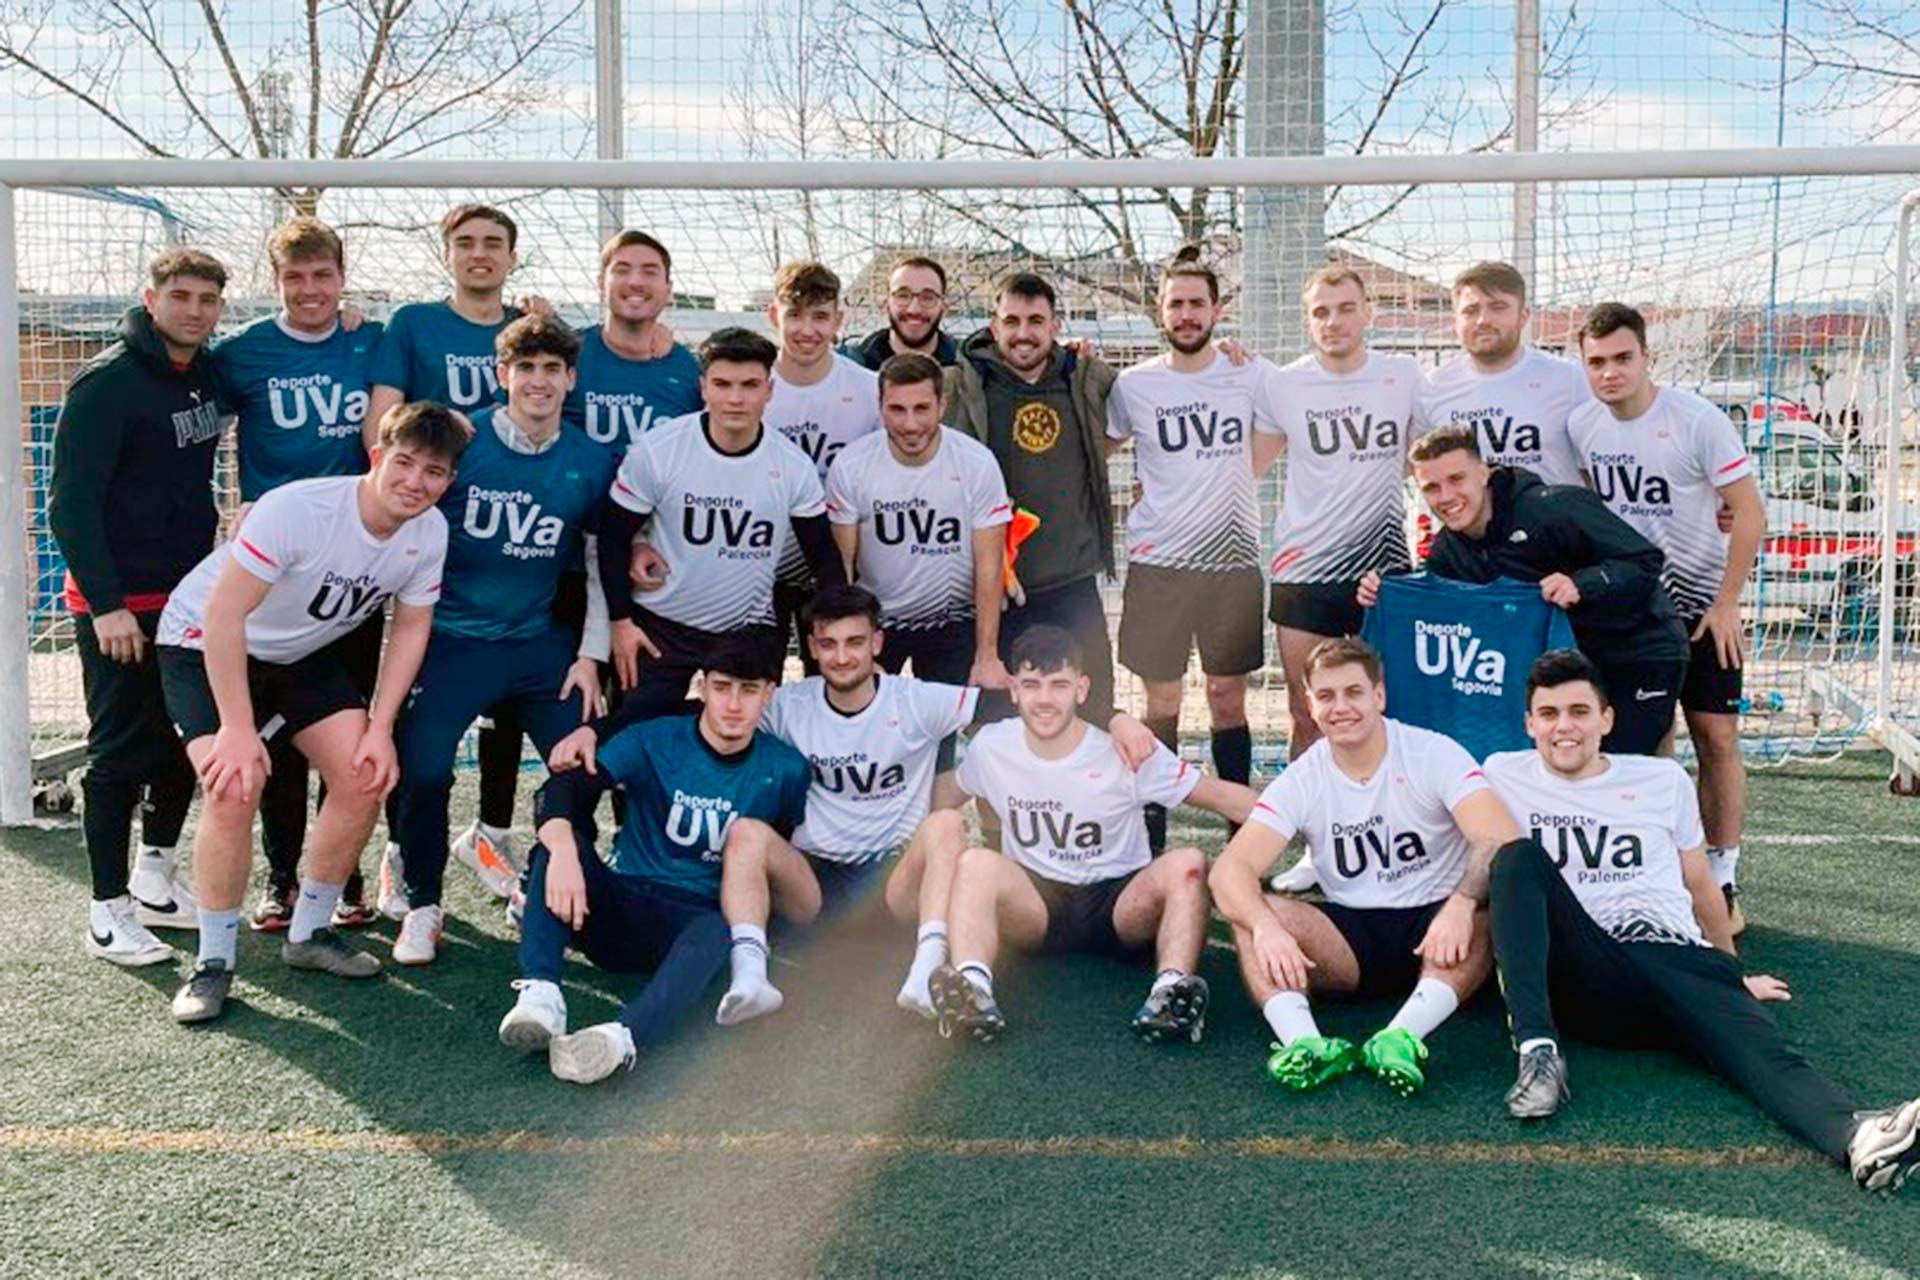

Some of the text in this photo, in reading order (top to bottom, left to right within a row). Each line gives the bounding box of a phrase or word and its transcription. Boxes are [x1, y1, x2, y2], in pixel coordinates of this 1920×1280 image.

[267, 373, 332, 391] Deporte
[268, 383, 370, 430] UVa
[585, 391, 645, 408] Deporte
[1155, 401, 1209, 418] Deporte
[1305, 404, 1362, 421] Deporte
[1450, 406, 1504, 424] Deporte
[1157, 410, 1243, 453] UVa
[1307, 413, 1399, 456] UVa
[788, 432, 846, 468] Va
[1590, 451, 1636, 465] Deporte
[467, 484, 533, 503] Deporte
[1592, 463, 1671, 505] UVa
[684, 493, 743, 509] Deporte
[872, 498, 929, 513] Deporte
[1619, 503, 1674, 517] Palencia
[463, 497, 565, 546] UVa
[682, 506, 775, 548] UVa
[874, 508, 961, 546] UVa
[501, 542, 556, 560] Segovia
[717, 547, 772, 561] Palencia
[1414, 619, 1473, 639] Deporte
[1415, 633, 1507, 685] UVa
[809, 753, 868, 771] Deporte
[814, 762, 905, 795] UVa
[674, 789, 732, 813] Deporte
[1007, 795, 1063, 812] Deporte
[1009, 809, 1103, 849] UVa
[1333, 829, 1427, 879] UVa
